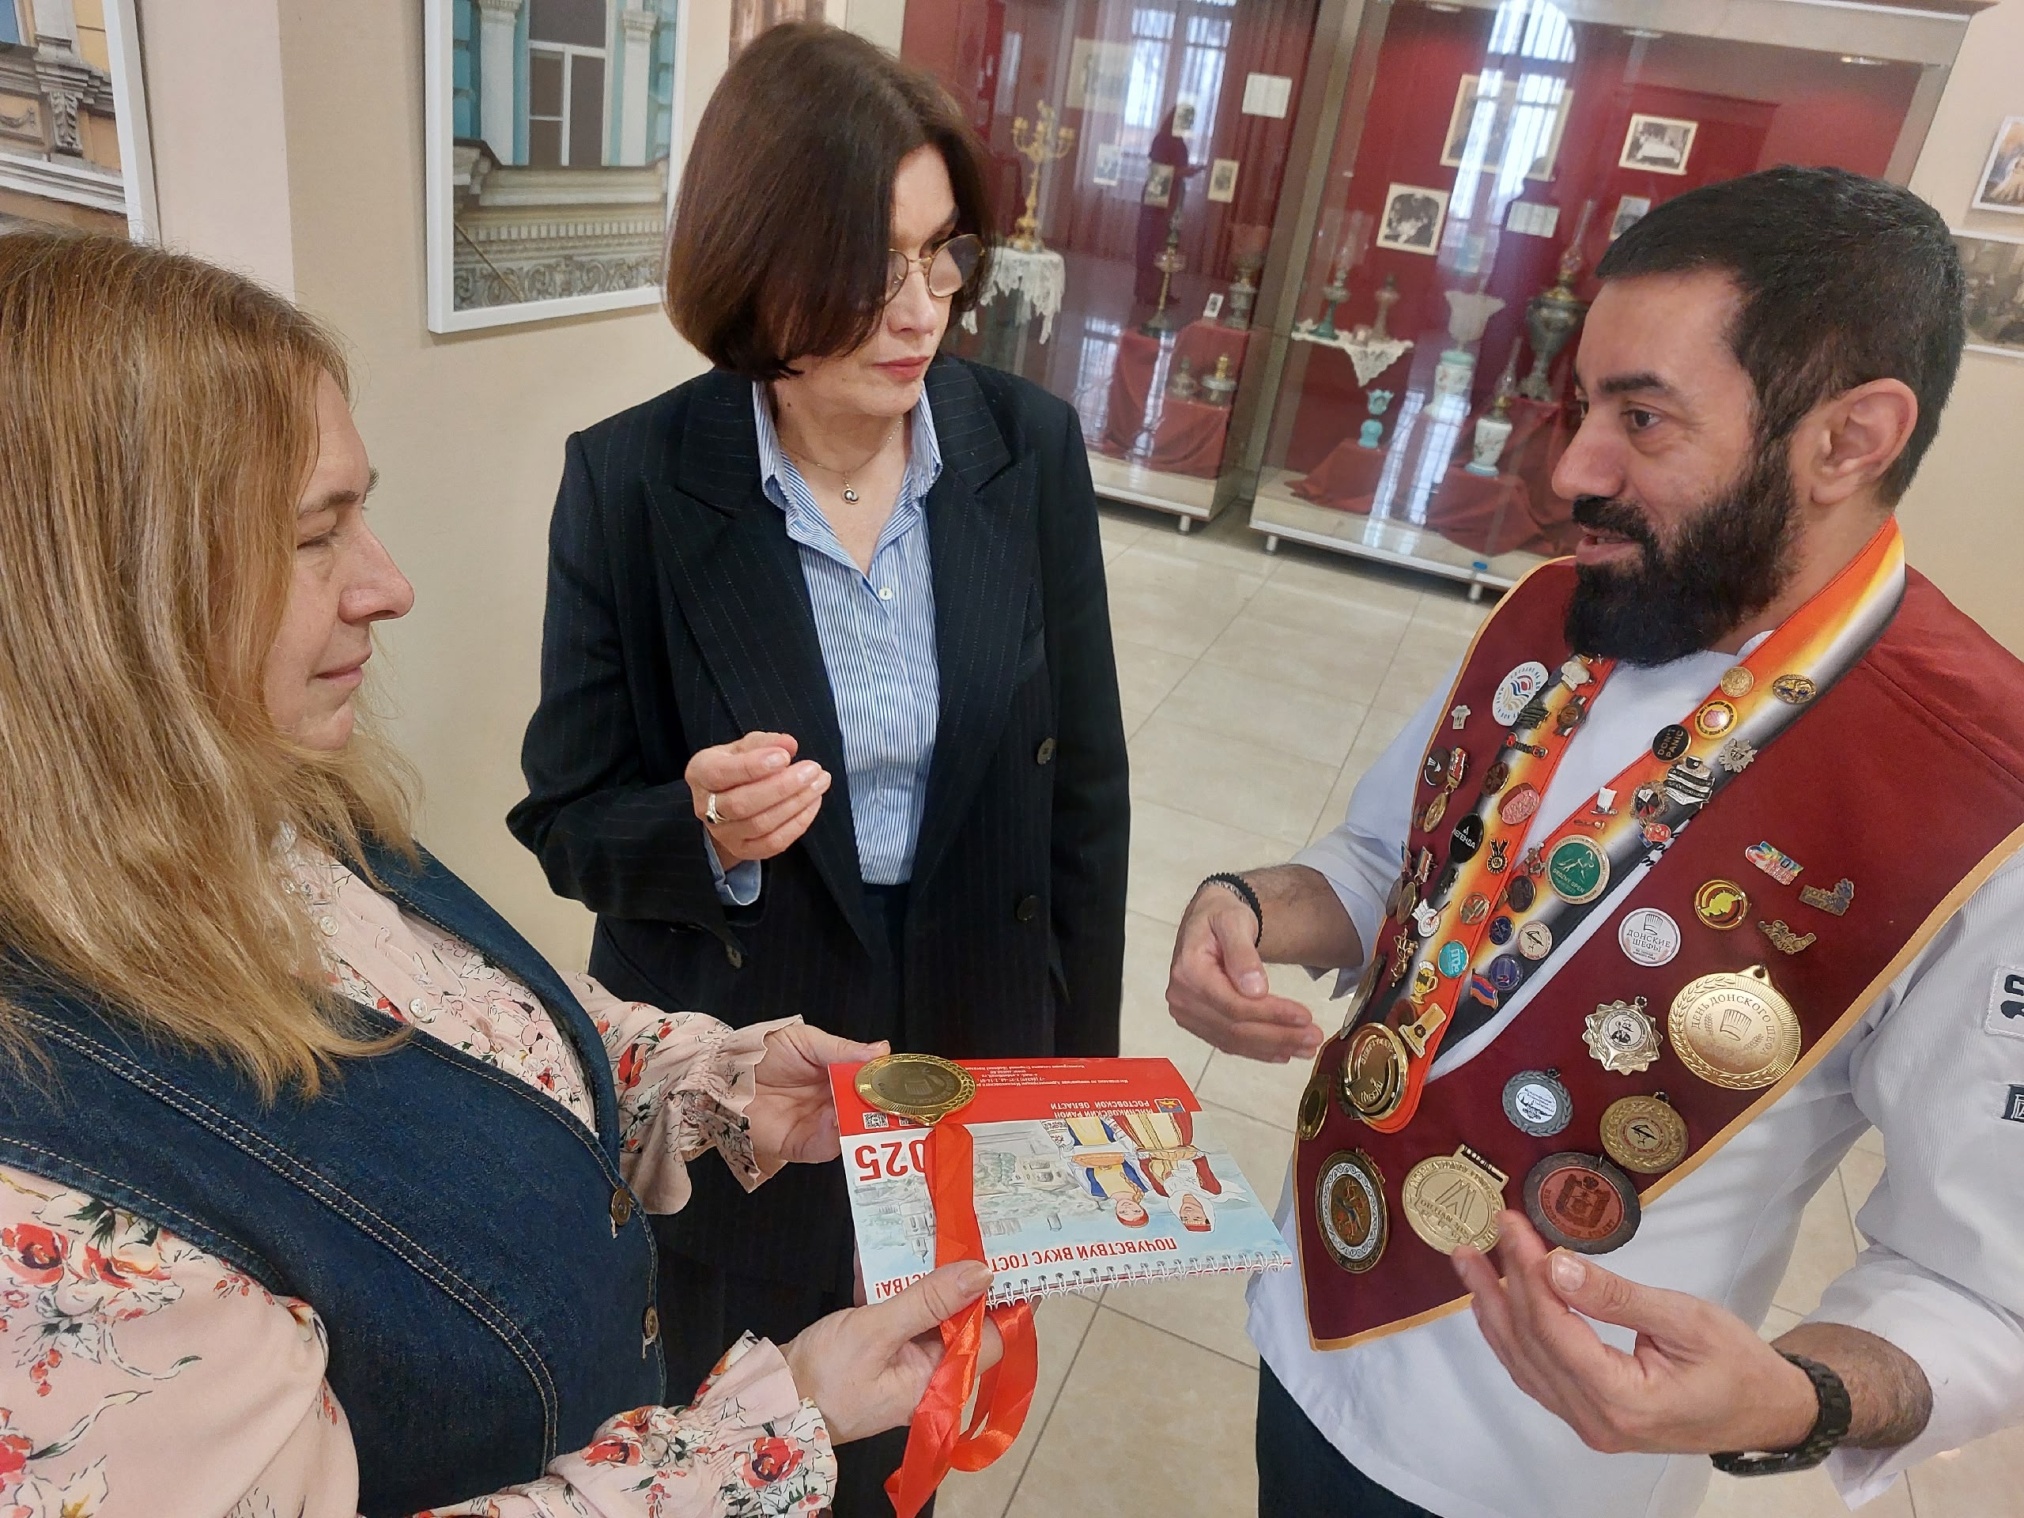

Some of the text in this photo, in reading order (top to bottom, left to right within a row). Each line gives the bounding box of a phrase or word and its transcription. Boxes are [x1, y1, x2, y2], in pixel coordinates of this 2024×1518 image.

[1658, 727, 1676, 755] DON'T
[1666, 730, 1684, 757] PANIC
[1626, 930, 1671, 948] ДОНСКИЕ
[1632, 938, 1662, 952] ШЕФЫ
[1691, 1002, 1710, 1030] ДЕНЬ
[1709, 994, 1771, 1023] ДОНСКОГО
[1050, 1100, 1150, 1110] РОСТОВСКОЙ ОБЛАСТИ
[855, 1139, 925, 1181] 025
[1034, 1246, 1073, 1264] ВКУС
[1076, 1237, 1177, 1261] ПОЧУВСТВУЙ
